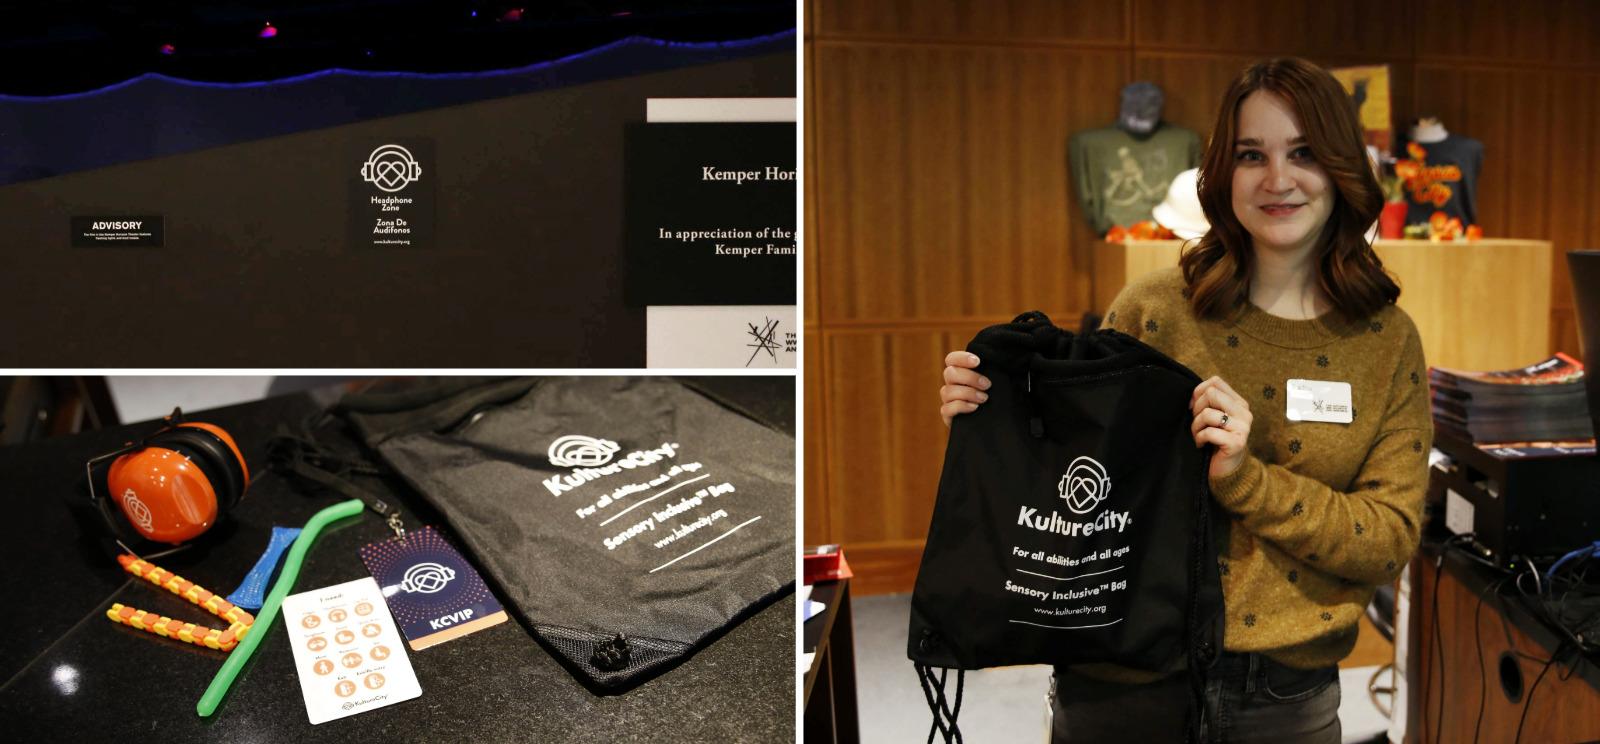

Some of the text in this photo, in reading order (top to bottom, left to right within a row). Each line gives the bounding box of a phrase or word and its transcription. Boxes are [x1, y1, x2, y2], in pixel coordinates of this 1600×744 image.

[702, 166, 761, 185] Kemper
[371, 196, 413, 206] Headphone
[92, 221, 142, 230] ADVISORY
[376, 218, 408, 226] Zona De
[659, 228, 673, 239] In
[675, 228, 753, 242] appreciation
[755, 227, 771, 239] of
[772, 227, 792, 239] the
[715, 244, 797, 258] Kemper Fami
[597, 494, 613, 508] all
[603, 517, 655, 550] Sensory
[707, 482, 736, 498] Bag
[1012, 545, 1130, 567] For all abilities and all ages
[1005, 580, 1050, 601] Sensory
[1111, 580, 1127, 592] Bag
[1033, 605, 1107, 616] www.kulturecity.org
[429, 608, 474, 630] KCVIP
